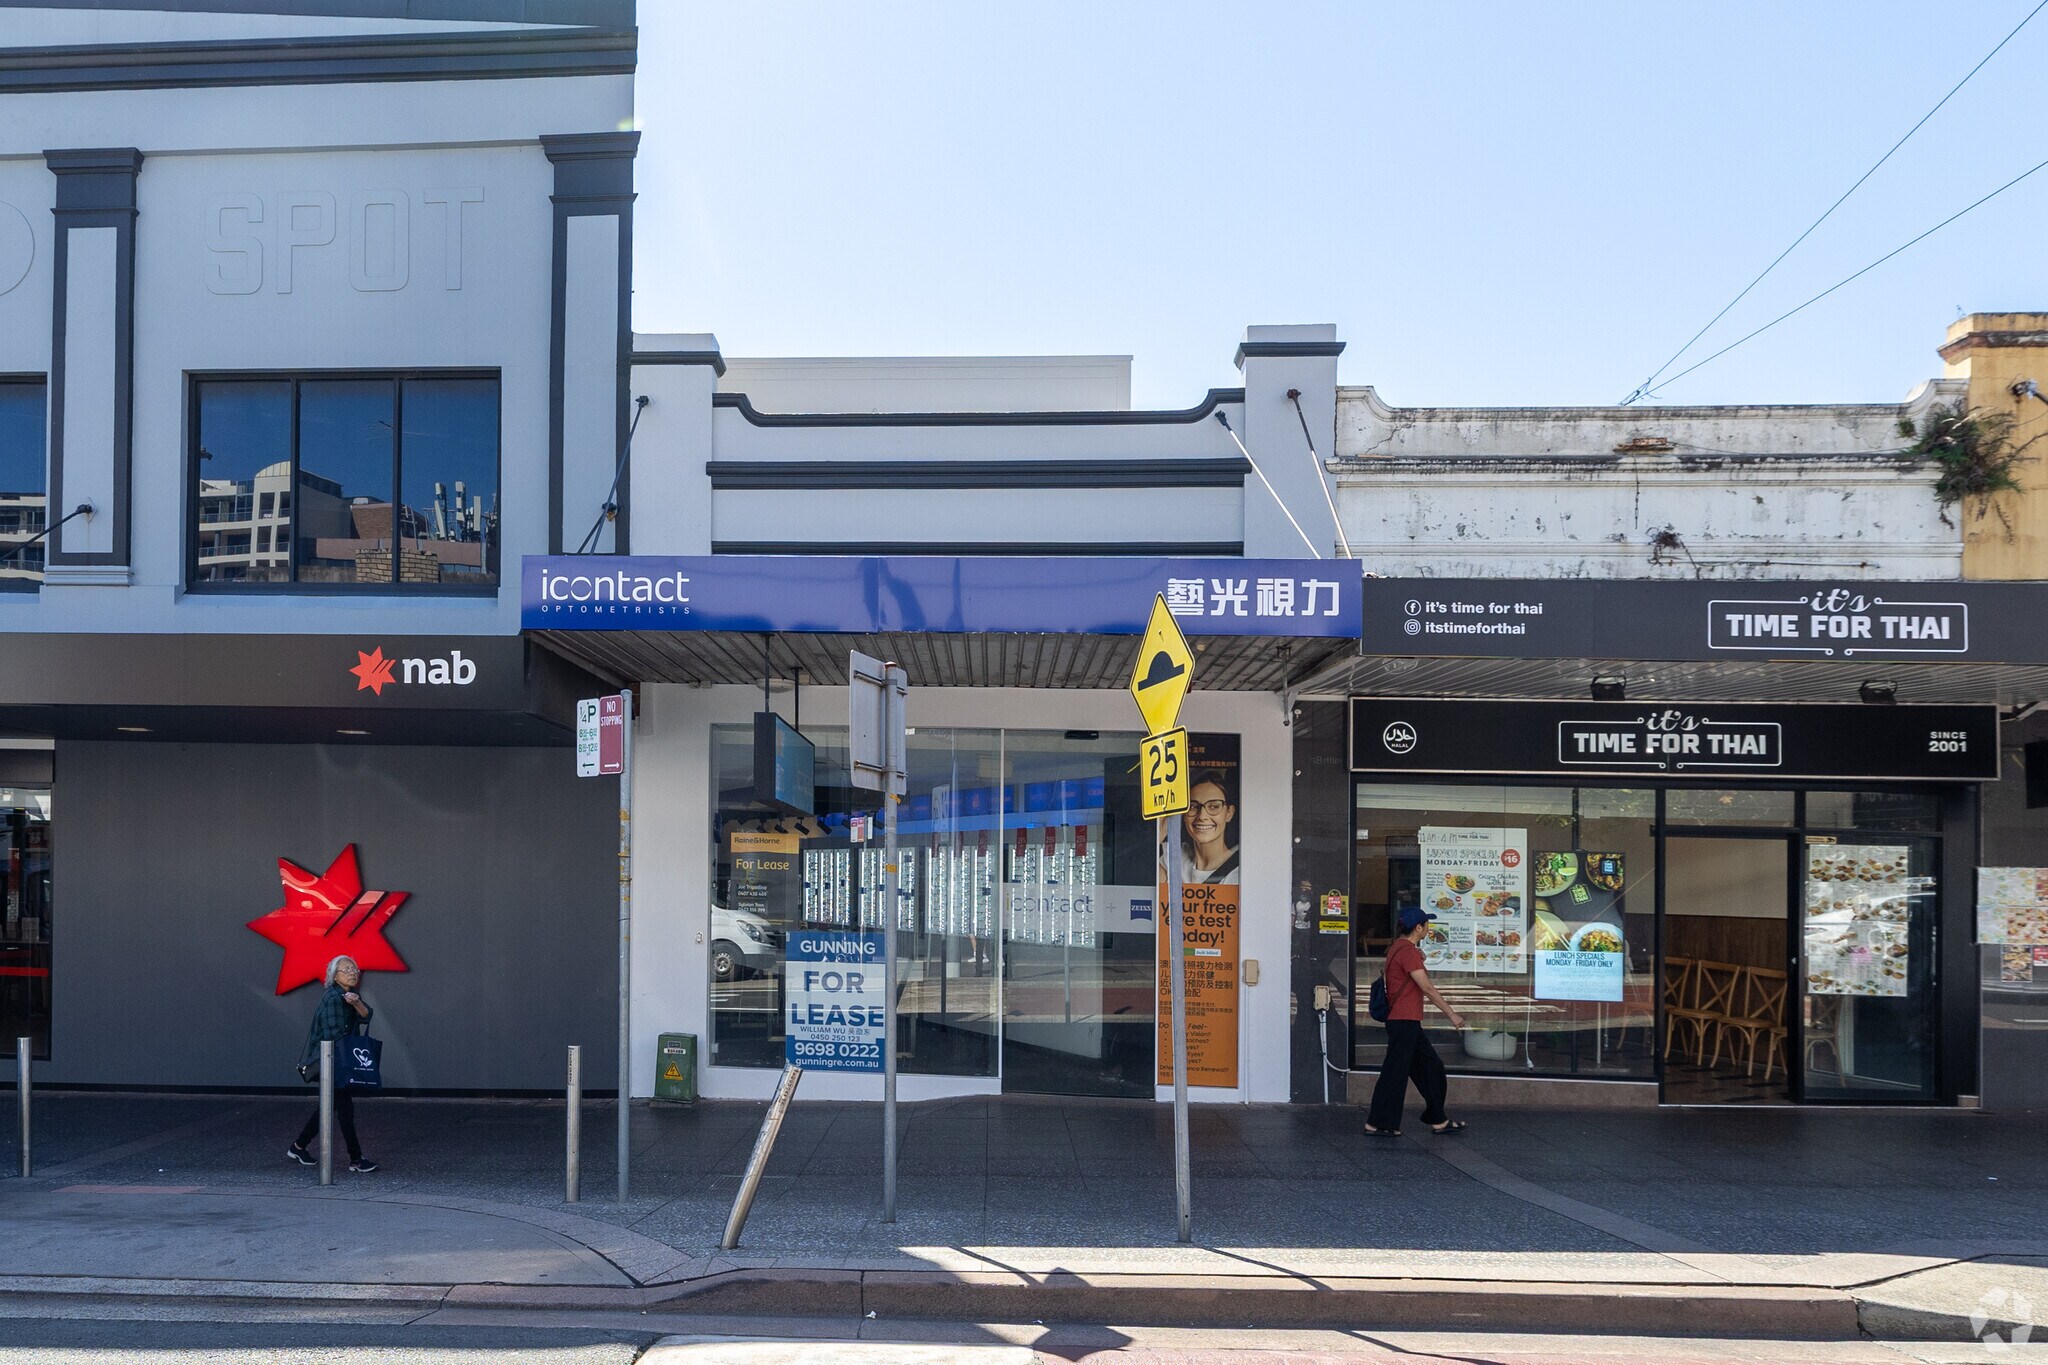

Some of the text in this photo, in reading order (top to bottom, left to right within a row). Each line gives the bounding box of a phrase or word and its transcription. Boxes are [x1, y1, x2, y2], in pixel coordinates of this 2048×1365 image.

[204, 186, 486, 297] SPOT
[541, 569, 690, 602] icontact
[1167, 578, 1340, 617] 藝光視力
[1811, 588, 1872, 612] it's
[541, 604, 690, 615] OPTOMETRISTS
[1451, 602, 1485, 614] time
[1488, 602, 1511, 614] for
[1514, 603, 1543, 615] thai
[1425, 622, 1526, 635] itstimeforthai
[1726, 614, 1950, 640] TIME FOR THAI
[402, 650, 477, 685] nab
[606, 701, 616, 713] NO
[600, 714, 623, 726] STOPPING
[1646, 709, 1700, 732] it's
[1386, 728, 1414, 741] حلال
[1930, 731, 1967, 740] SINCE
[1574, 732, 1767, 755] TIME FOR THAI
[1929, 740, 1967, 753] 2001
[1149, 739, 1178, 788] 25
[1153, 788, 1176, 807] km/h
[734, 837, 781, 845] Raine&Horne
[735, 859, 790, 871] For Lease
[1426, 859, 1500, 867] MONDAY-FRIDAY
[1181, 886, 1216, 900] ook
[1006, 893, 1093, 914] icontact
[1161, 900, 1237, 917] yur free
[1199, 914, 1232, 928] test
[1183, 929, 1225, 947] day!
[800, 940, 876, 955] GUNNING
[1597, 960, 1614, 968] ONLY
[804, 971, 865, 993] FOR
[791, 1003, 884, 1028] LEASE
[831, 1034, 846, 1042] 250
[795, 1042, 880, 1058] 9698 0222
[795, 1058, 879, 1068] gunningre.com.au
